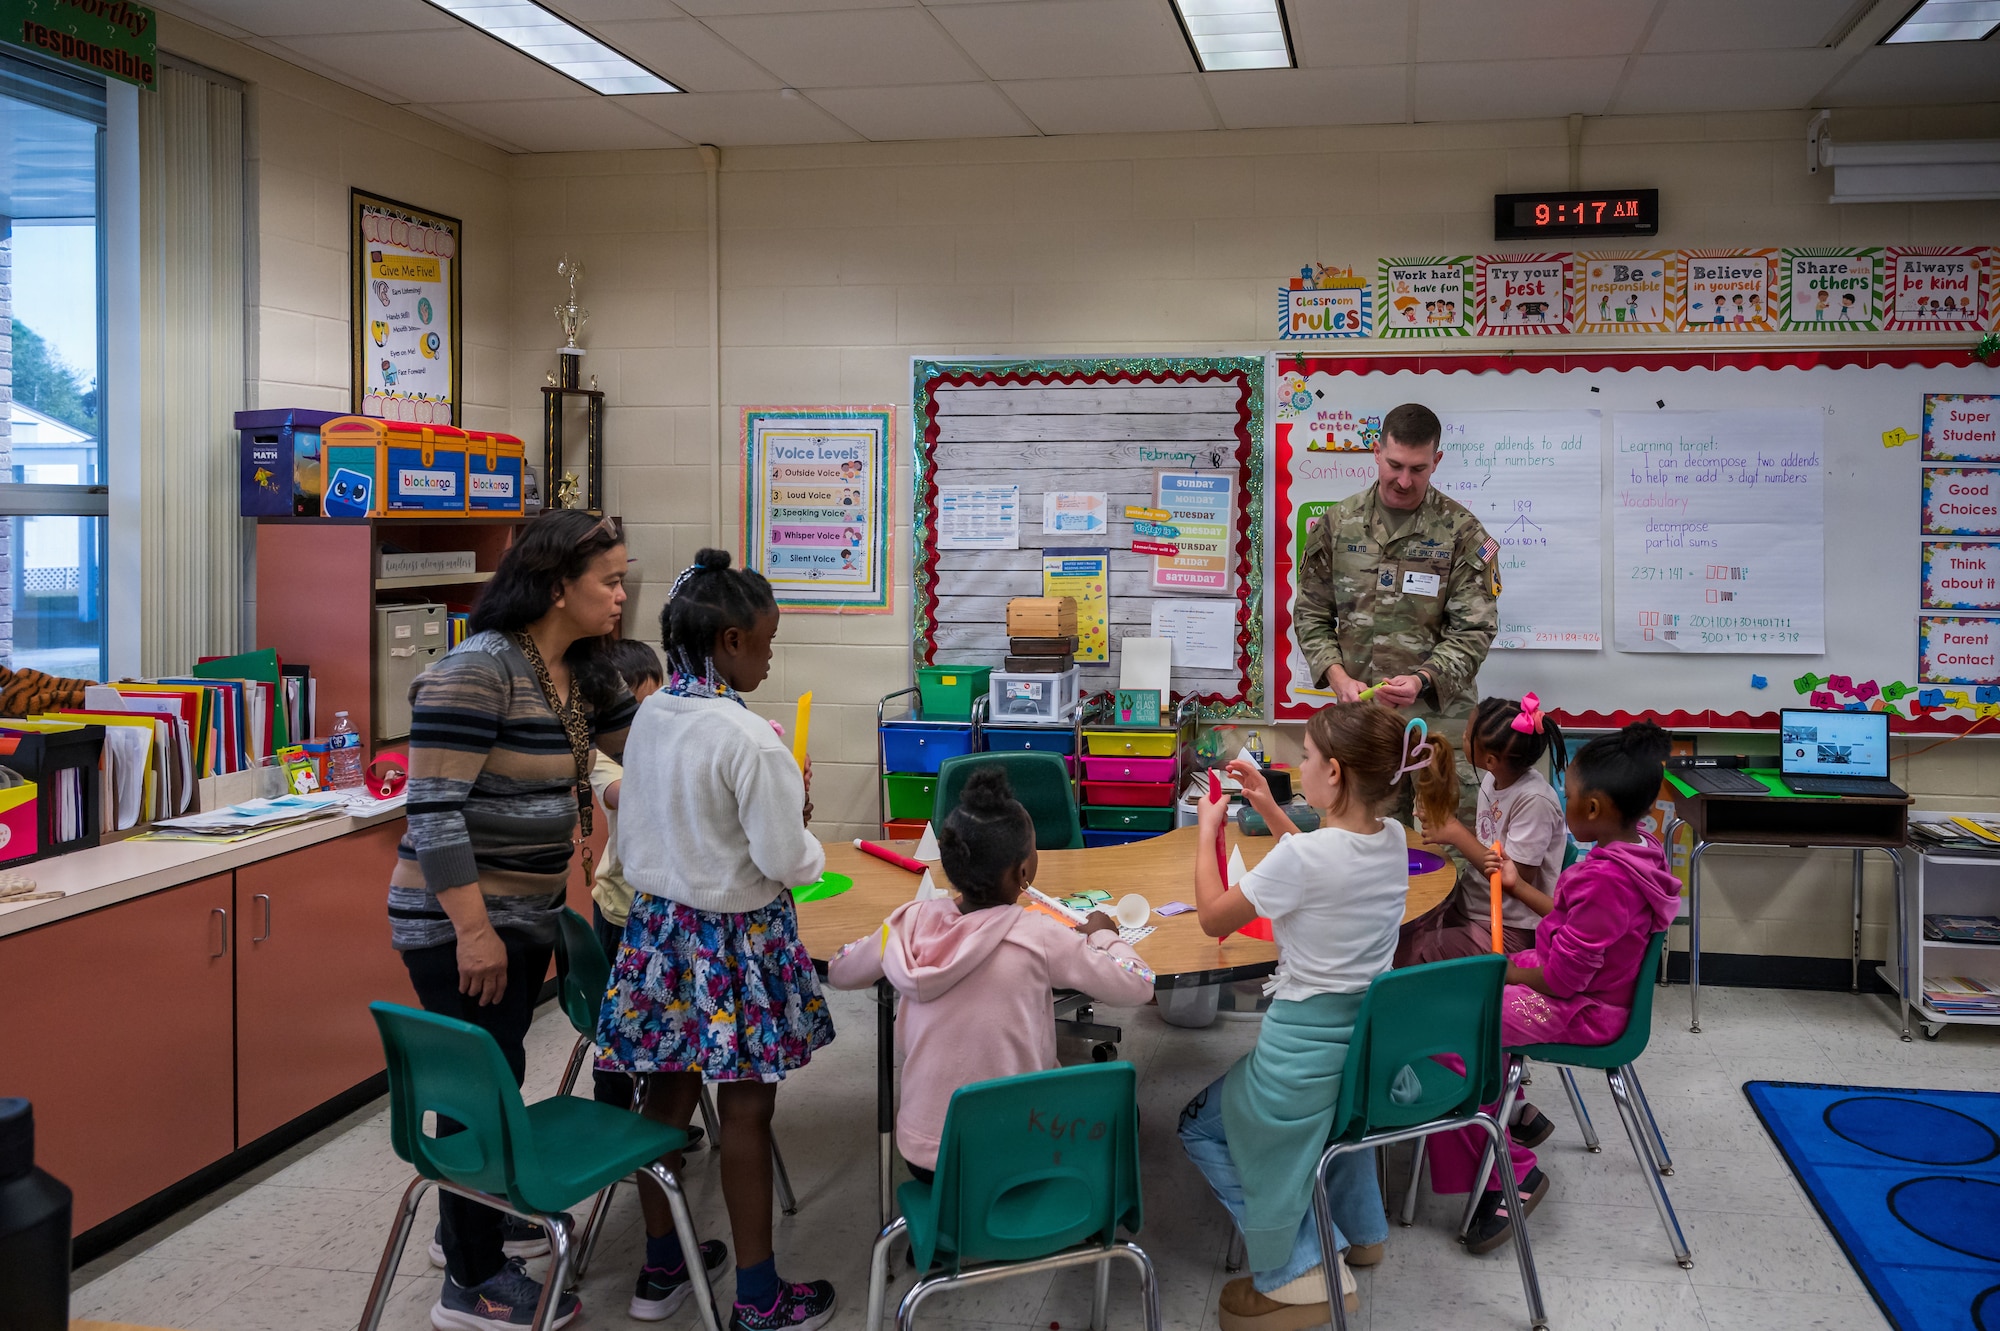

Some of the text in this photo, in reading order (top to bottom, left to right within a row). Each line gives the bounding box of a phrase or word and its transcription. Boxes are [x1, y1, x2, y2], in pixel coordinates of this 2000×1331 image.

[23, 20, 153, 84] responsible
[1535, 200, 1639, 226] 9:17 AM
[380, 264, 435, 278] Give Me Five!
[1393, 269, 1461, 280] Work hard
[1613, 264, 1644, 283] Be
[1693, 266, 1763, 280] Believe
[1796, 261, 1871, 275] Share with
[1903, 261, 1965, 274] Always
[1491, 268, 1560, 282] Try your
[1396, 280, 1459, 294] & have fun
[1505, 280, 1546, 298] best
[1590, 280, 1661, 295] responsible
[1693, 280, 1762, 293] in yourself
[1809, 275, 1869, 291] others
[1903, 274, 1969, 292] be kind
[1296, 296, 1353, 307] Classroom
[1292, 307, 1360, 332] rules
[1316, 410, 1352, 420] Math
[1950, 409, 1991, 426] Super
[1310, 421, 1358, 432] Center
[1942, 428, 1996, 442] Student
[1494, 435, 1535, 451] addends
[1542, 437, 1552, 450] to
[1561, 434, 1583, 450] add
[1620, 435, 1719, 456] Learning target:
[775, 446, 859, 460] Voice Levels
[1139, 446, 1198, 467] February
[1463, 451, 1555, 473] 3 digit numbers
[1643, 451, 1820, 473] I can decompose two addends
[772, 468, 841, 478] 4 Outside Voice
[1299, 459, 1375, 487] Santiago
[1631, 469, 1643, 484] to
[1646, 469, 1669, 487] help
[1675, 475, 1689, 484] me
[1695, 468, 1718, 483] add
[1764, 468, 1808, 484] numbers
[773, 491, 779, 500] 3
[787, 491, 806, 499] Loud
[1948, 484, 1989, 497] Good
[1512, 500, 1533, 512] 189
[1620, 491, 1689, 516] Vocabulary
[1939, 502, 1998, 516] Choices
[773, 508, 845, 519] 2 Speaking Voice
[1135, 523, 1171, 536] today is
[1645, 517, 1710, 537] decompose
[773, 531, 840, 541] 1 Whisper Voice
[1645, 533, 1718, 554] partial sums
[772, 554, 836, 563] 0 Silent Voice
[1419, 549, 1434, 557] SPACE
[1435, 550, 1450, 560] FORCE
[1499, 554, 1527, 569] value
[1950, 558, 1987, 571] Think
[1631, 566, 1656, 580] 237
[1669, 567, 1683, 580] 141
[1940, 577, 1996, 590] about it
[1499, 640, 1515, 649] 426
[1701, 631, 1724, 644] 300
[1735, 632, 1748, 642] 70
[1760, 632, 1767, 642] 8
[1778, 631, 1800, 642] 378
[1943, 632, 1989, 646] Parent
[1937, 652, 1995, 666] Contact
[1816, 696, 1828, 705] 12
[1924, 693, 1933, 701] 7
[1984, 690, 1991, 698] 4
[1136, 701, 1155, 710] CLASS
[1983, 705, 1991, 713] 5
